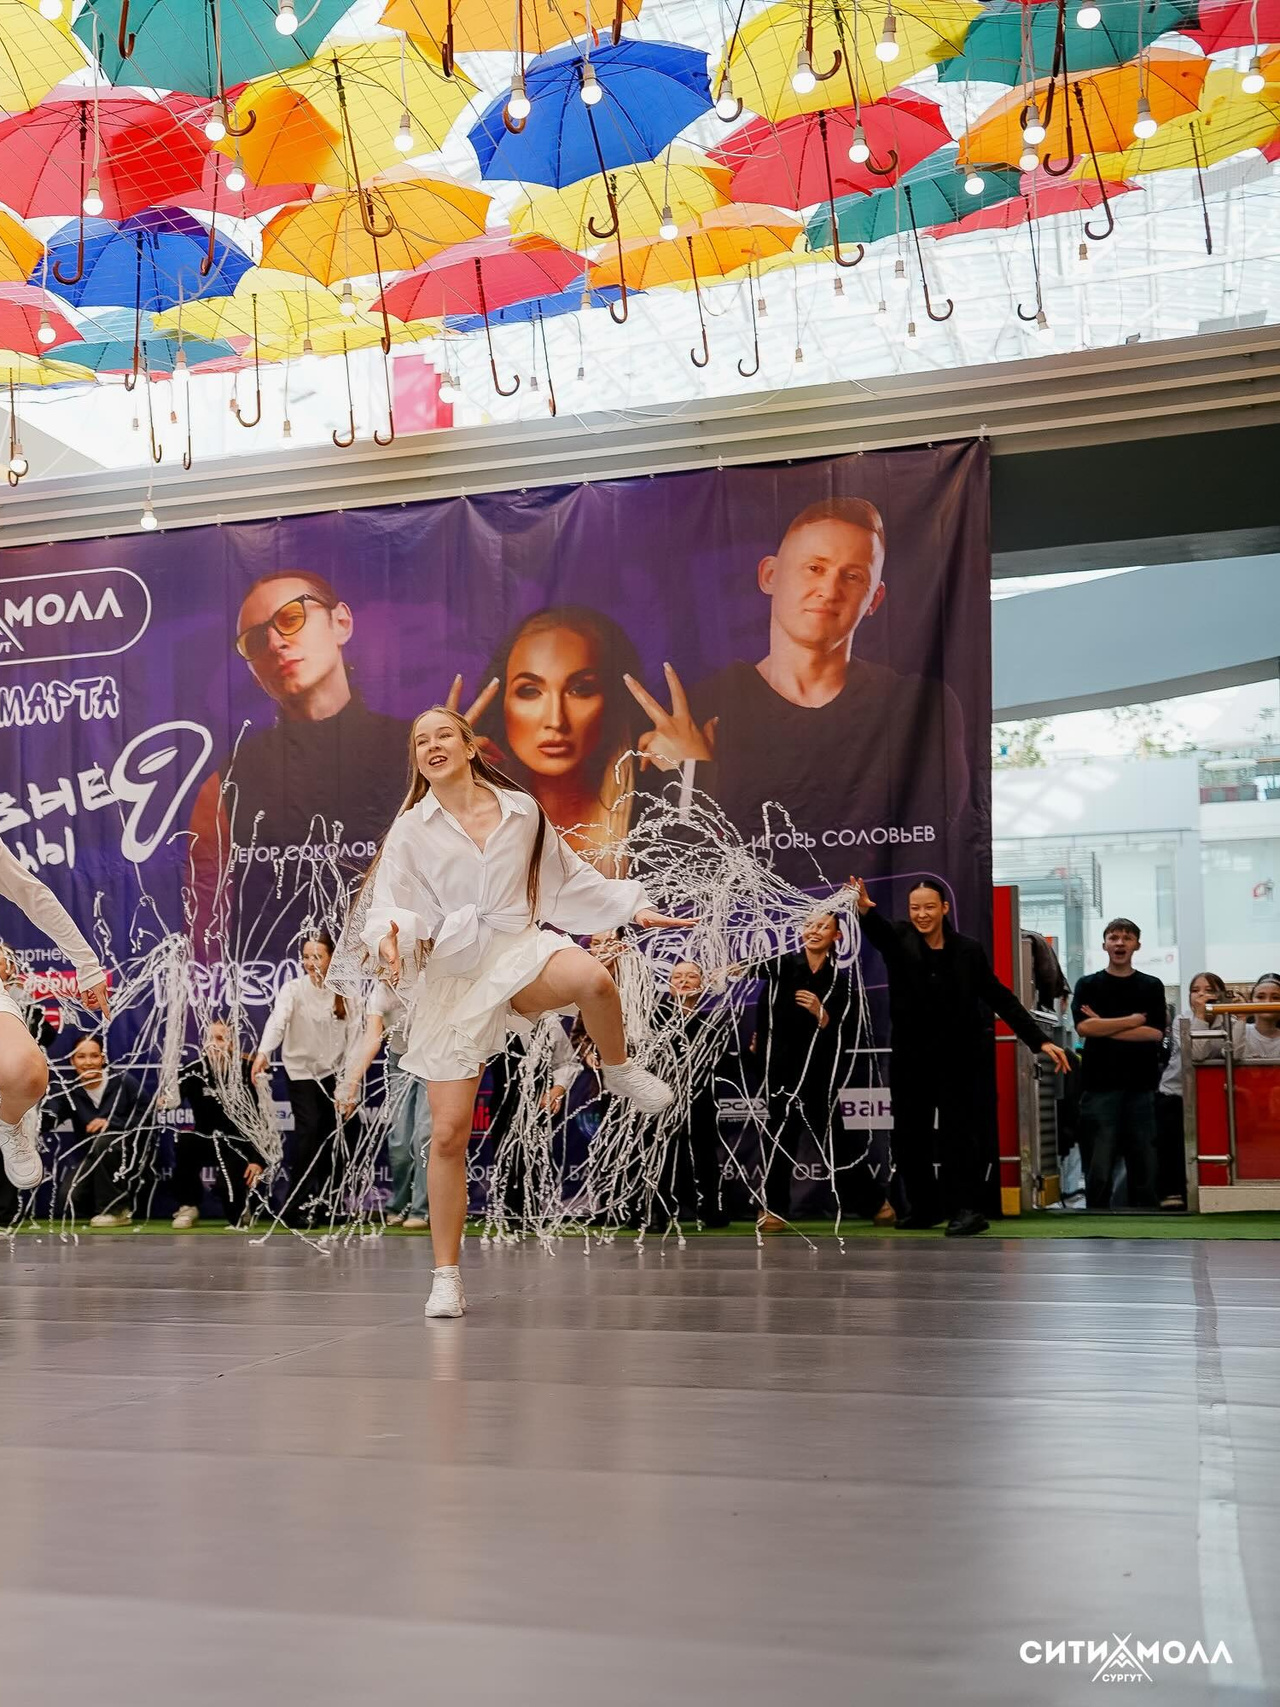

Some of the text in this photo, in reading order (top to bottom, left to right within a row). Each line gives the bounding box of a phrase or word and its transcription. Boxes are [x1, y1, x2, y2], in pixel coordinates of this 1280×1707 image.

[4, 587, 124, 627] МОЛЛ
[751, 825, 936, 850] ИГОРЬ СОЛОВЬЕВ
[237, 840, 377, 863] ЕГОР СОКОЛОВ
